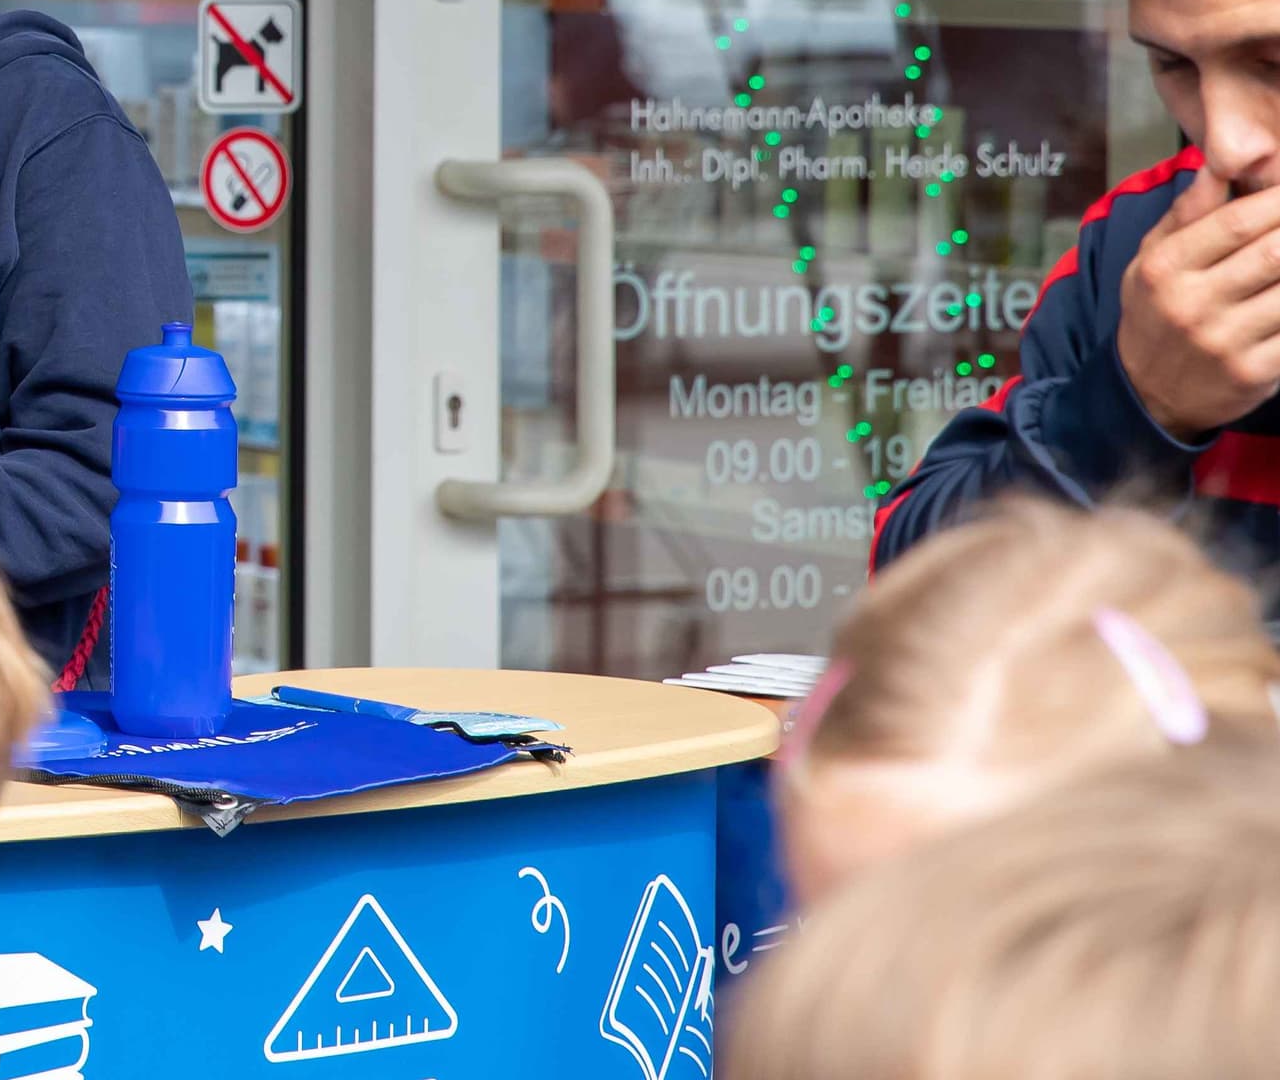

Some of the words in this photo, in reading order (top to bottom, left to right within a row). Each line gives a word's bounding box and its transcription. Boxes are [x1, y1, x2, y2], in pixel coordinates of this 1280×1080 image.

[630, 91, 943, 137] Hahnemann-Apotheke
[701, 144, 769, 191] Dipl.
[778, 144, 877, 181] Pharm.
[885, 141, 969, 180] Heide
[976, 139, 1066, 178] Schulz
[669, 373, 822, 426] Montag
[705, 436, 822, 484] 09.00
[705, 564, 822, 612] 09.00
